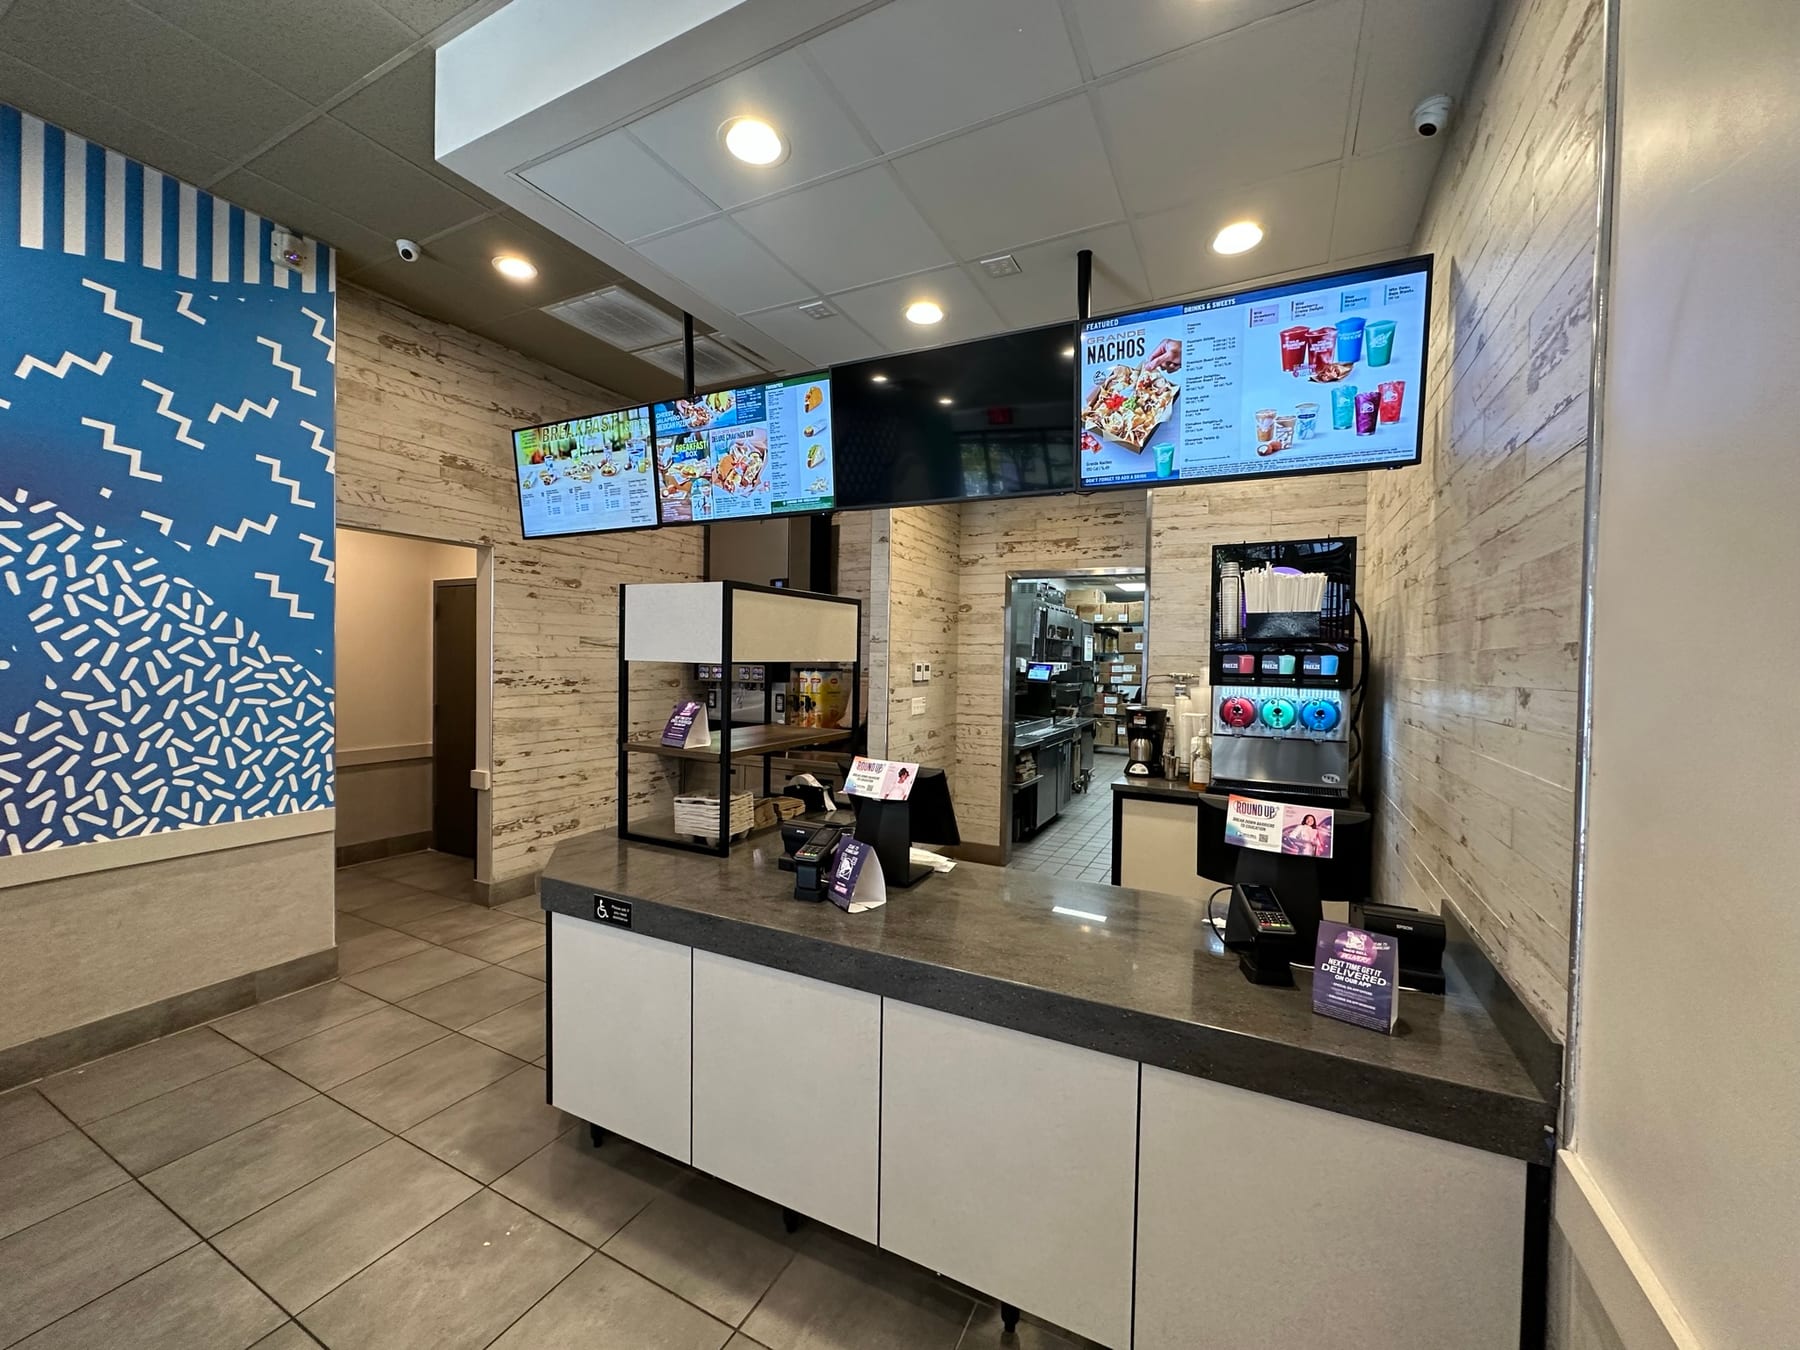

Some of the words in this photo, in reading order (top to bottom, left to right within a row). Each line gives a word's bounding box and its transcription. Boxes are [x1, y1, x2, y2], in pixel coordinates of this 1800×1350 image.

[1184, 302, 1206, 314] DRINKS
[1212, 298, 1236, 308] SWEETS
[1086, 319, 1118, 330] FEATURED
[1086, 328, 1146, 345] GRANDE
[1087, 337, 1145, 365] NACHOS
[542, 414, 620, 443] BREAKFAST
[675, 442, 706, 452] BREAKFAST
[1236, 801, 1263, 816] ROUND
[1264, 805, 1276, 819] UP
[1321, 963, 1387, 986] DELIVERED
[1328, 958, 1345, 968] NEXT
[1346, 962, 1361, 972] TIME
[1362, 966, 1374, 975] GET
